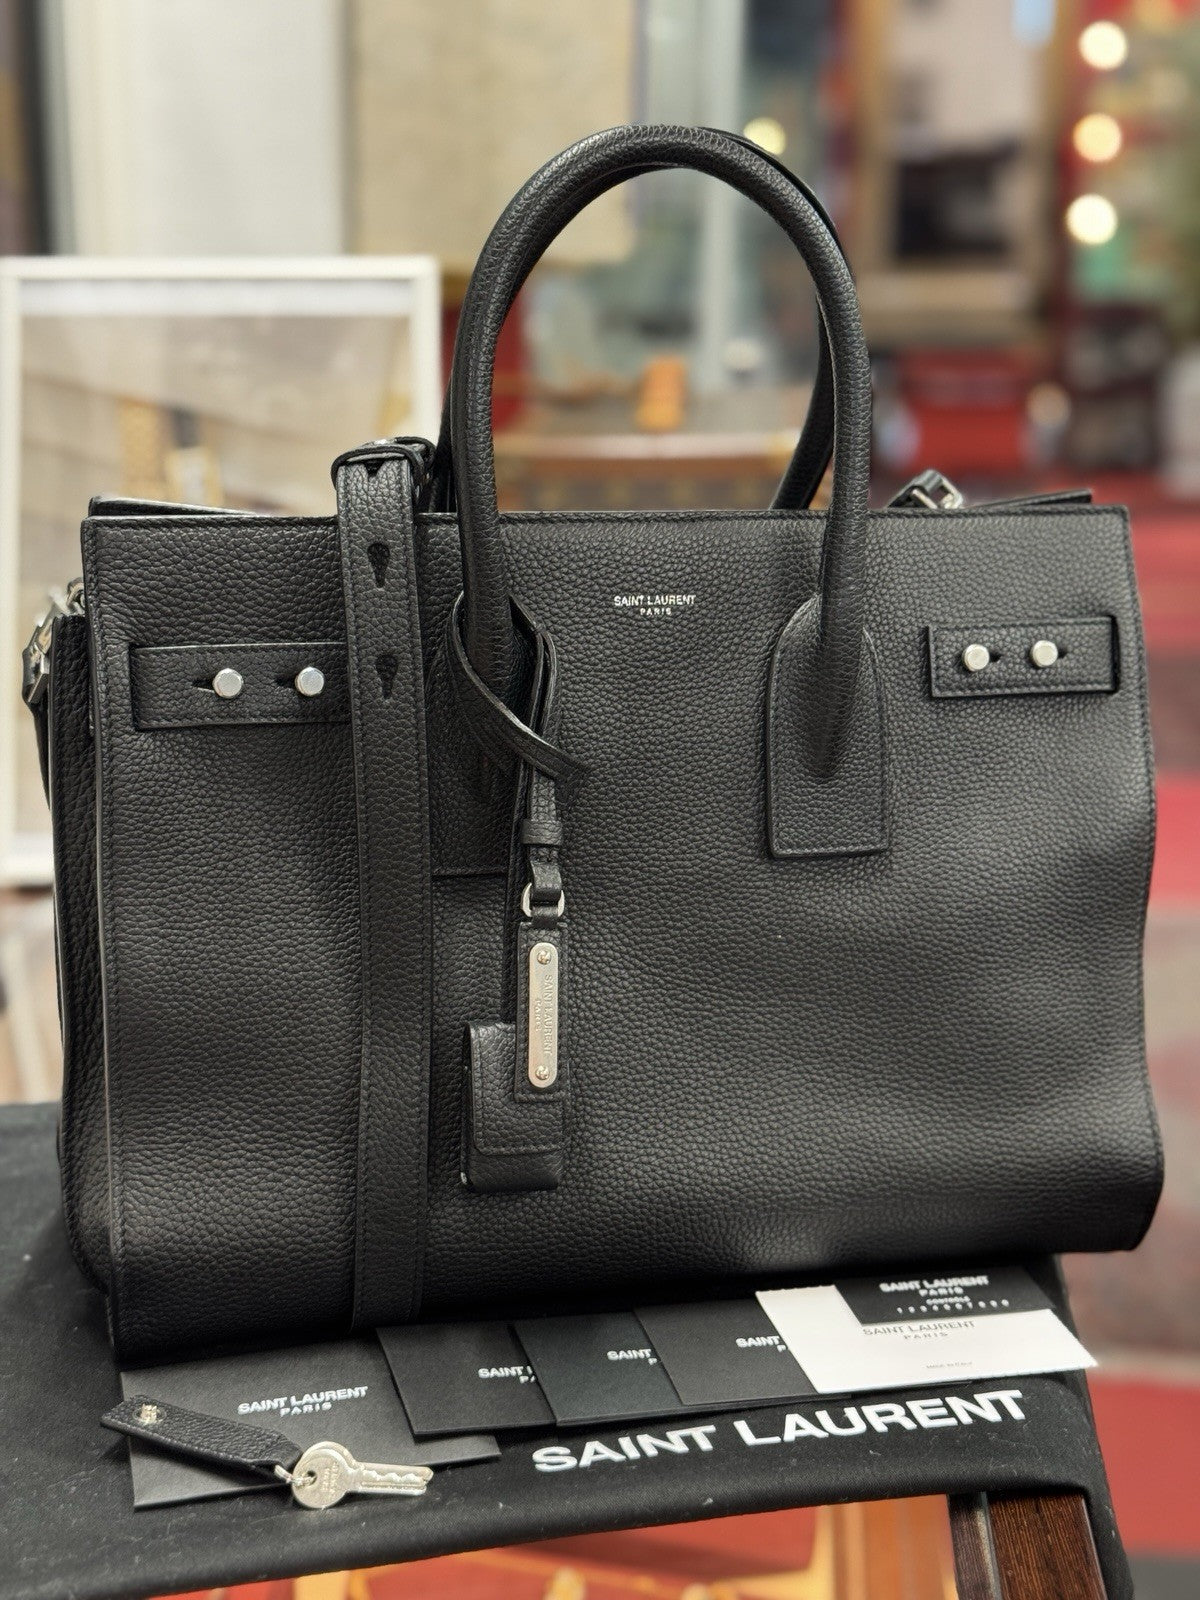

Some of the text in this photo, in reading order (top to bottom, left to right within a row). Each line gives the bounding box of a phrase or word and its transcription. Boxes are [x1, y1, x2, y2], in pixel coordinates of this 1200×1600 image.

[613, 595, 696, 606] SAINT LAURENT
[543, 974, 554, 1055] SAINT LAURENT
[879, 1275, 989, 1292] SAINT LAURENT
[862, 1320, 975, 1336] SAINT LAURENT
[903, 1331, 948, 1340] PARIS
[735, 1335, 780, 1348] SAINT
[607, 1348, 651, 1360] SAINT
[478, 1365, 524, 1379] SAINT
[237, 1386, 368, 1415] SAINT LAURENT
[280, 1401, 332, 1418] PARIS
[532, 1389, 1027, 1472] SAINT LAURENT
